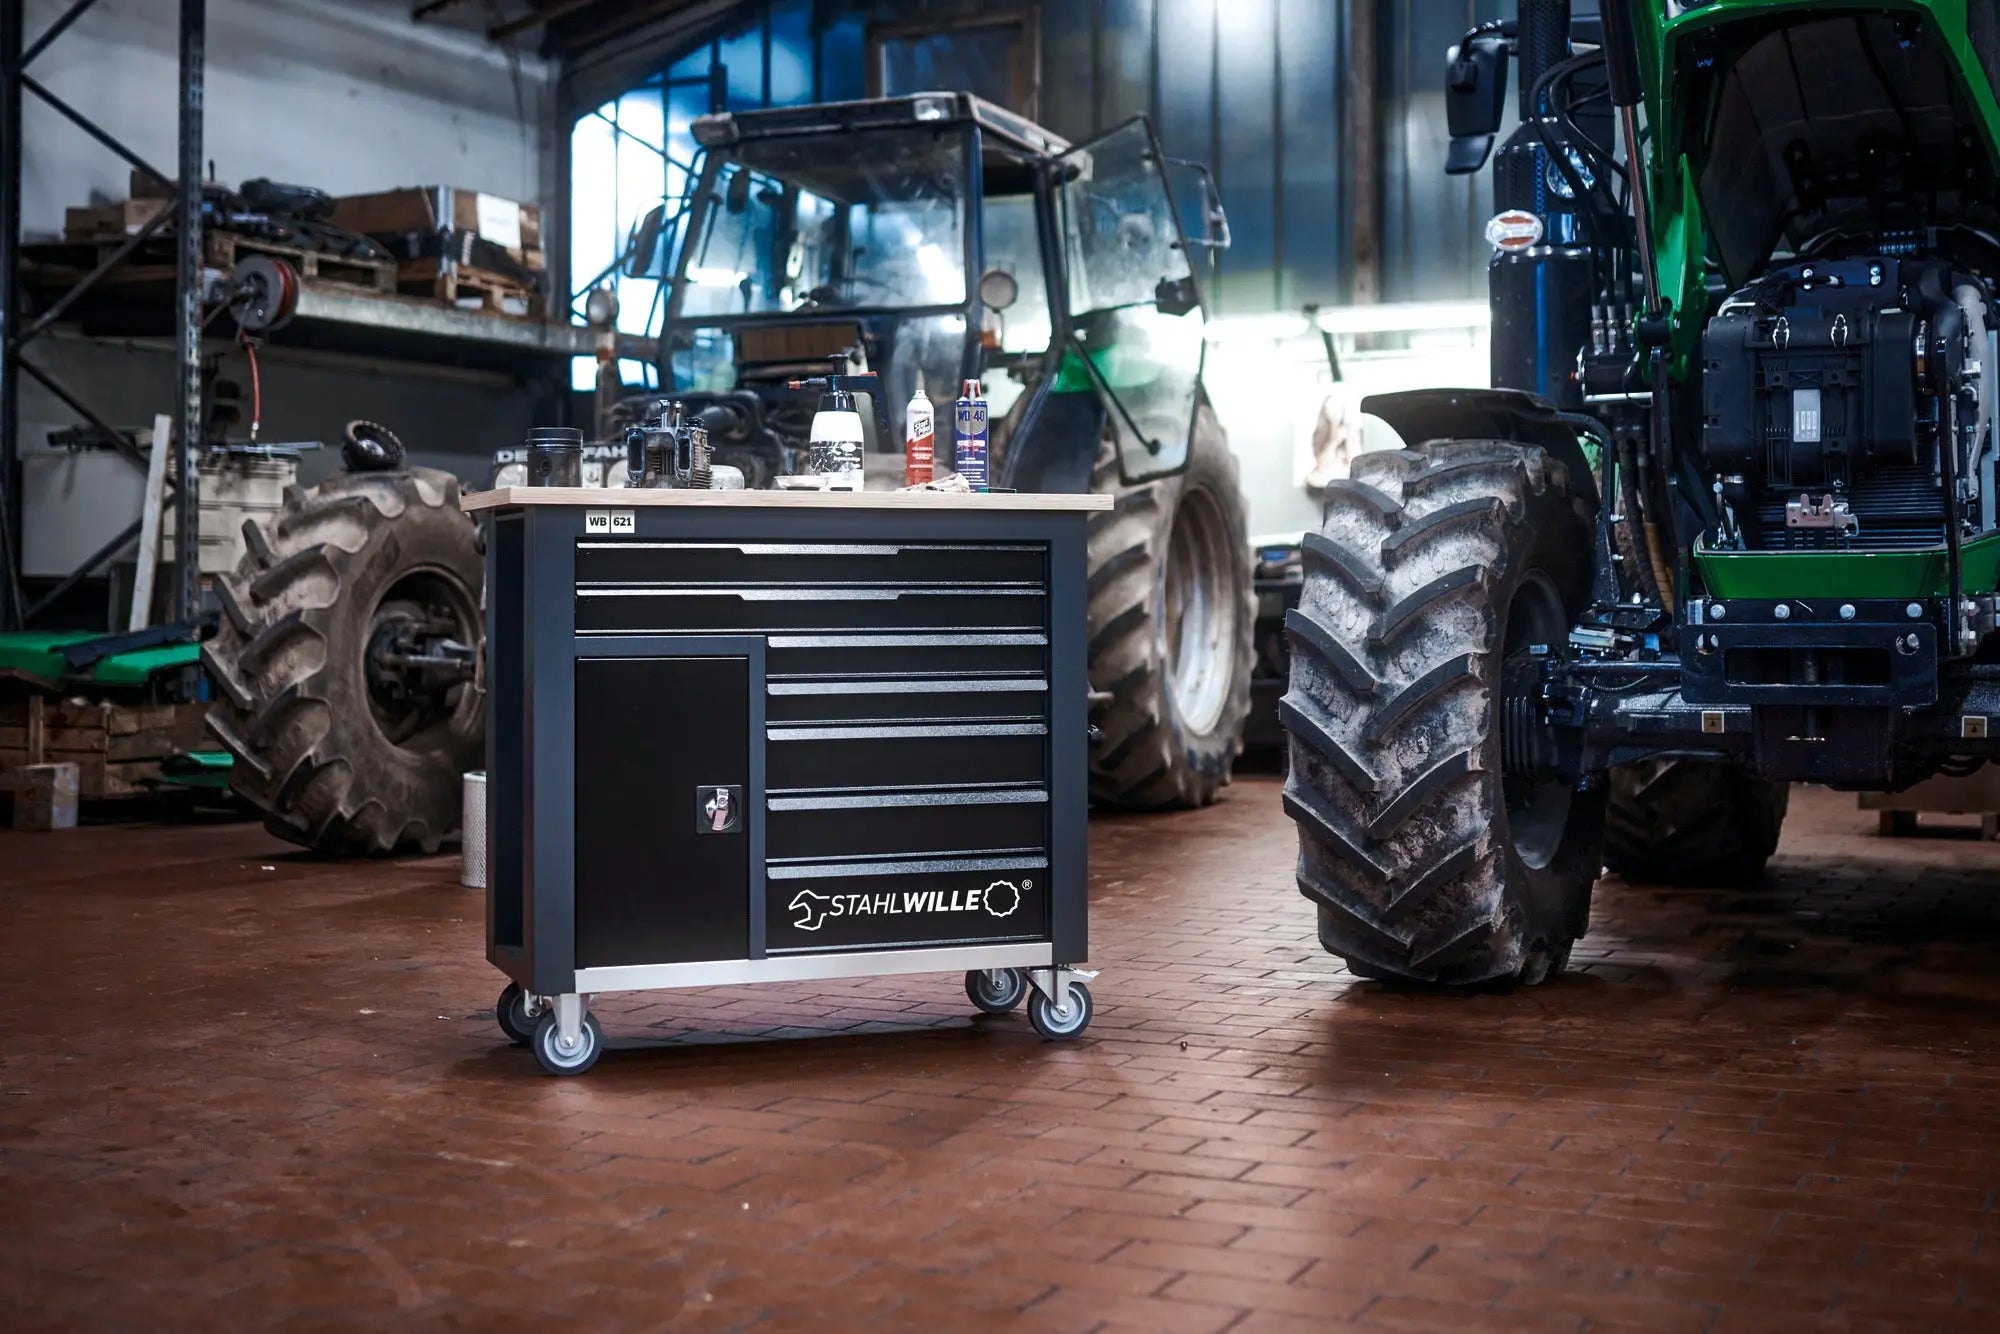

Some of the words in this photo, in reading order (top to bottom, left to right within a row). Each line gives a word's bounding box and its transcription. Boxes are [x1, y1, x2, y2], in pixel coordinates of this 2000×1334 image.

[589, 516, 607, 526] WB
[613, 516, 632, 526] 621
[829, 889, 982, 915] STAHLWILLE
